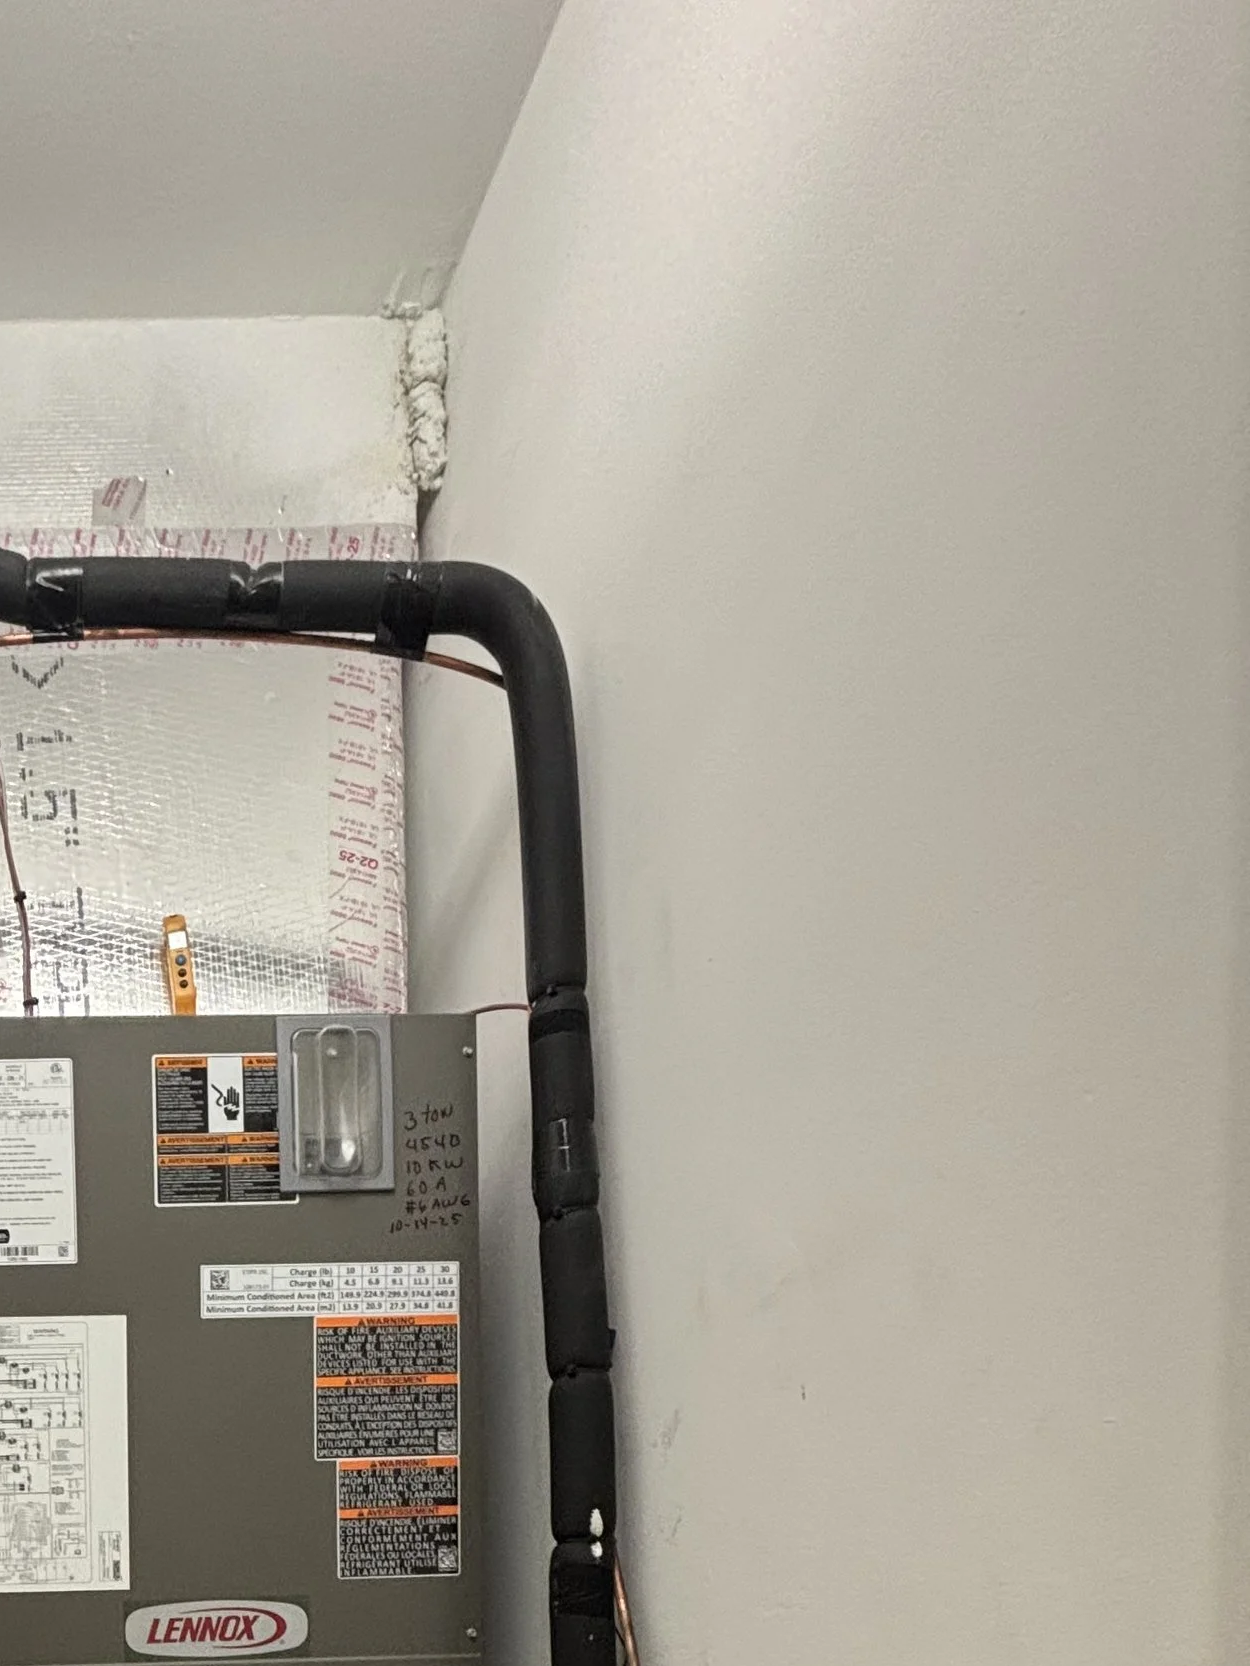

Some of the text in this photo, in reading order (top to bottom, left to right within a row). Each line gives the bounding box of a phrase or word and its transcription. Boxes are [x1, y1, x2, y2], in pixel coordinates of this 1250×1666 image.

[339, 850, 379, 870] Q2-25
[404, 1111, 417, 1131] 3
[407, 1161, 421, 1174] 10
[436, 1176, 446, 1191] A
[290, 1269, 316, 1277] Charge
[147, 1615, 260, 1644] LENNOX
